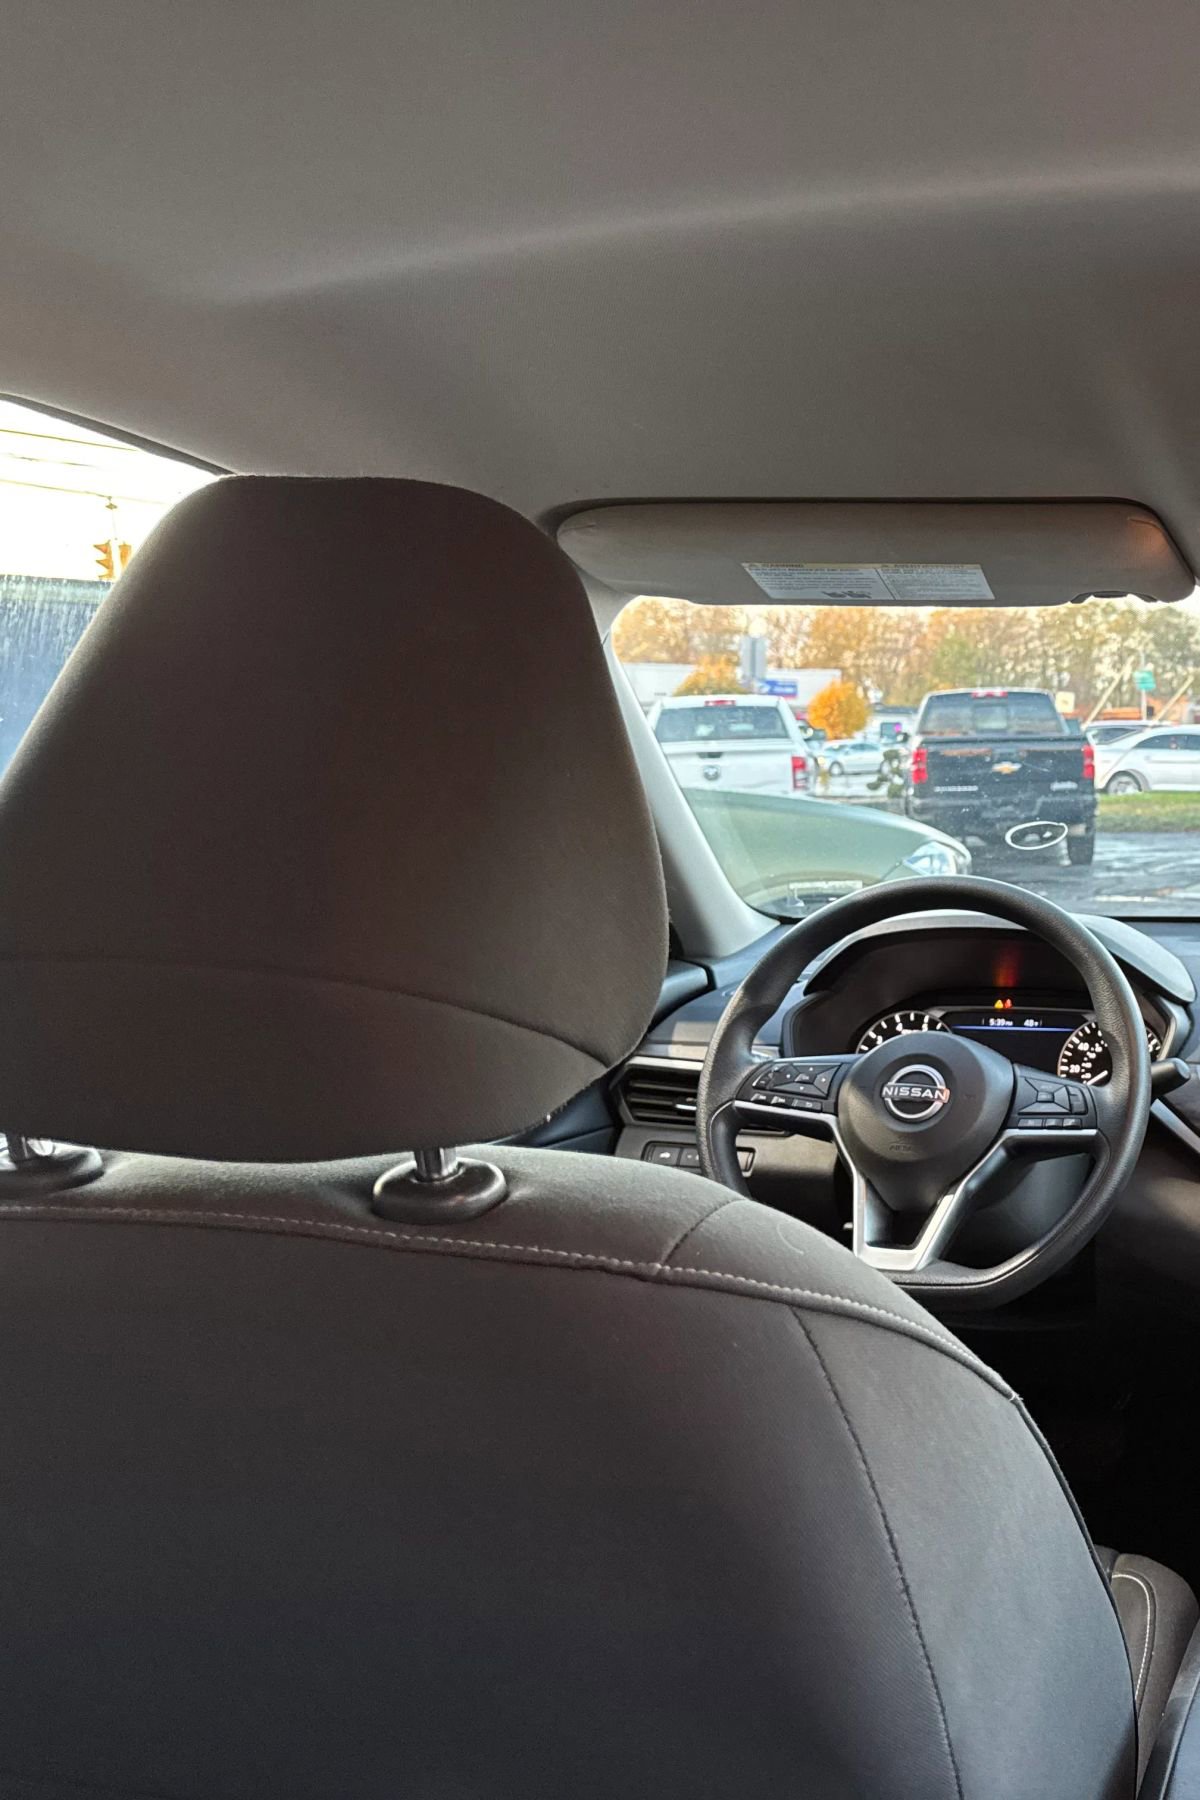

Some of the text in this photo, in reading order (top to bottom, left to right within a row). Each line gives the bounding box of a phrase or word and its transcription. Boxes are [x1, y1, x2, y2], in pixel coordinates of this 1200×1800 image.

[1078, 1042, 1089, 1051] 40
[1069, 1064, 1080, 1073] 20
[882, 1086, 946, 1101] NISSAN
